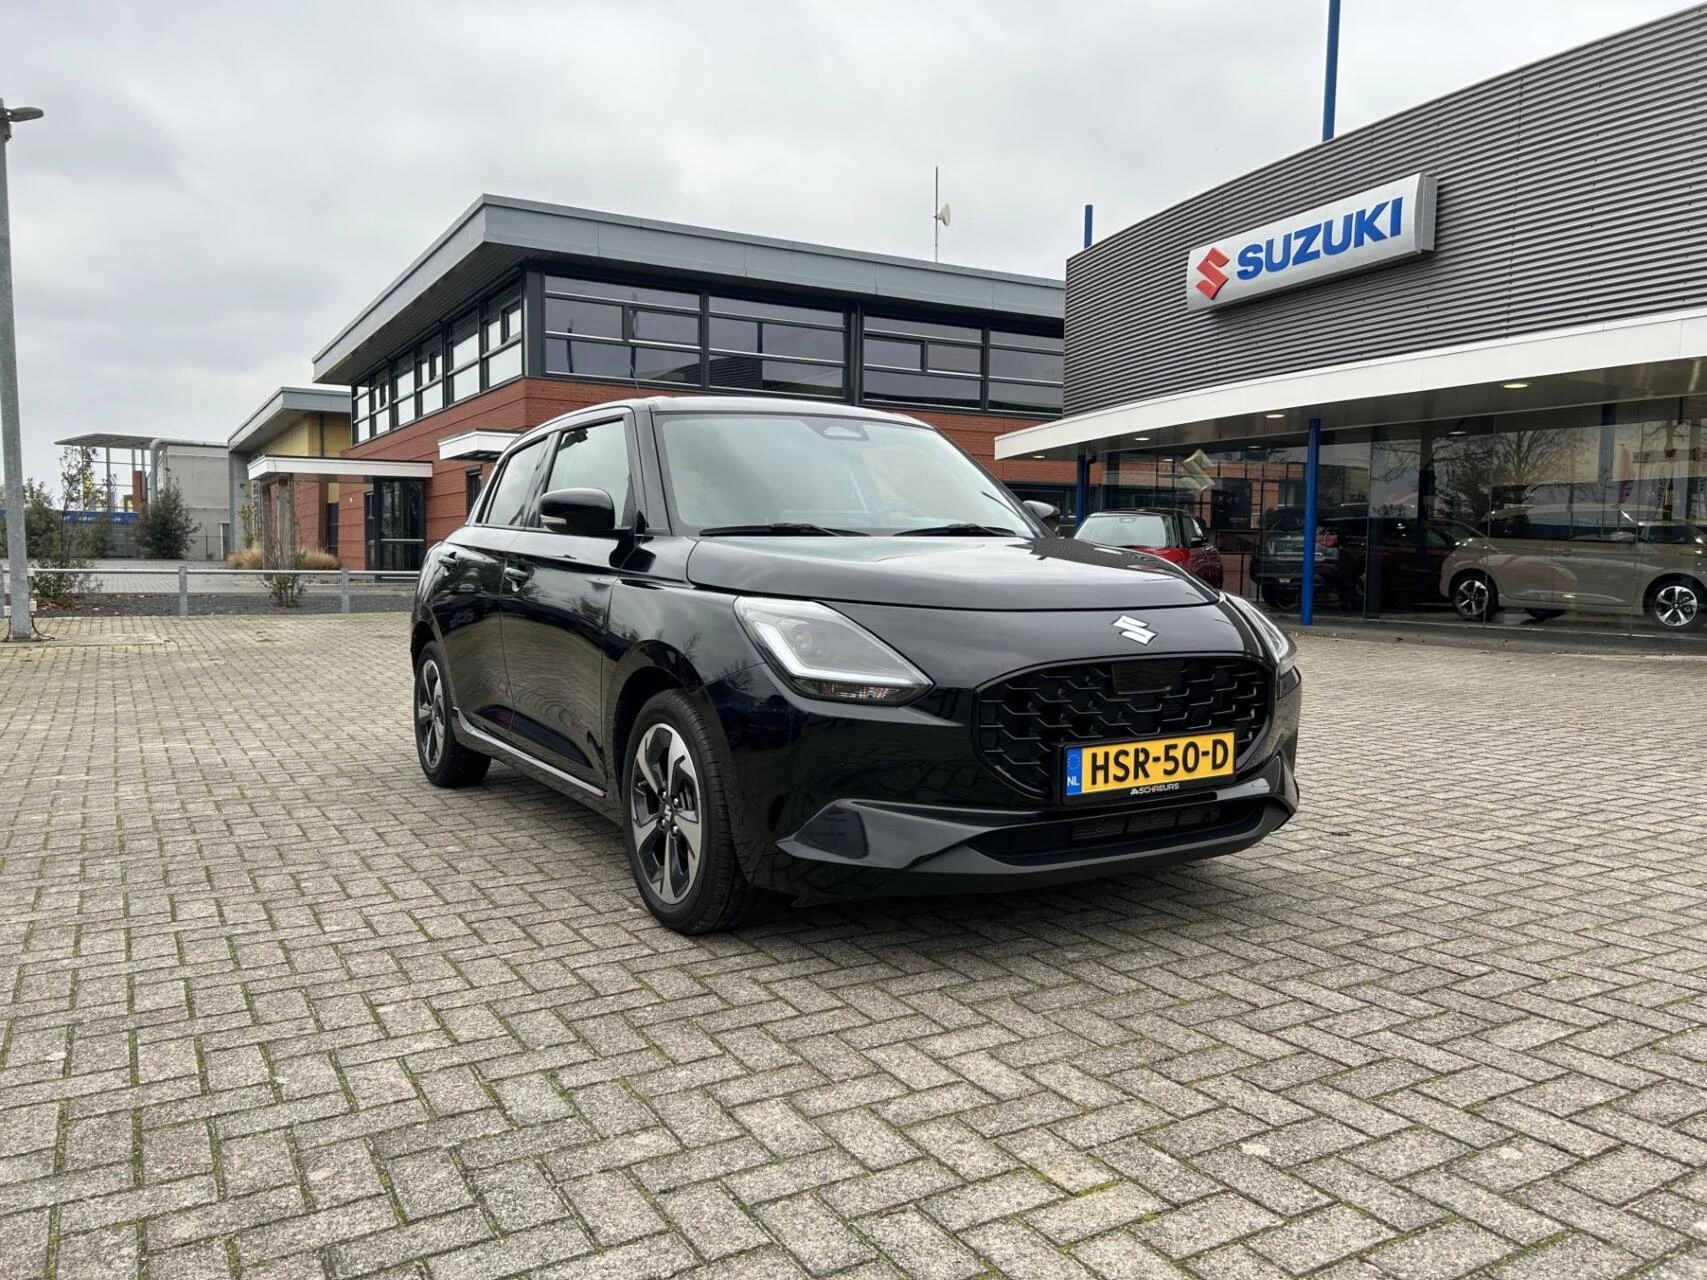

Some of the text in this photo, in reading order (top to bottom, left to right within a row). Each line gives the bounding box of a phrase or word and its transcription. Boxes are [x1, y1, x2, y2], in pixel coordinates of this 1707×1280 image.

[1237, 197, 1403, 280] SUZUKI
[1091, 738, 1229, 785] HSR-50-D
[1067, 776, 1080, 787] NL
[1139, 783, 1180, 794] SCHREURS
